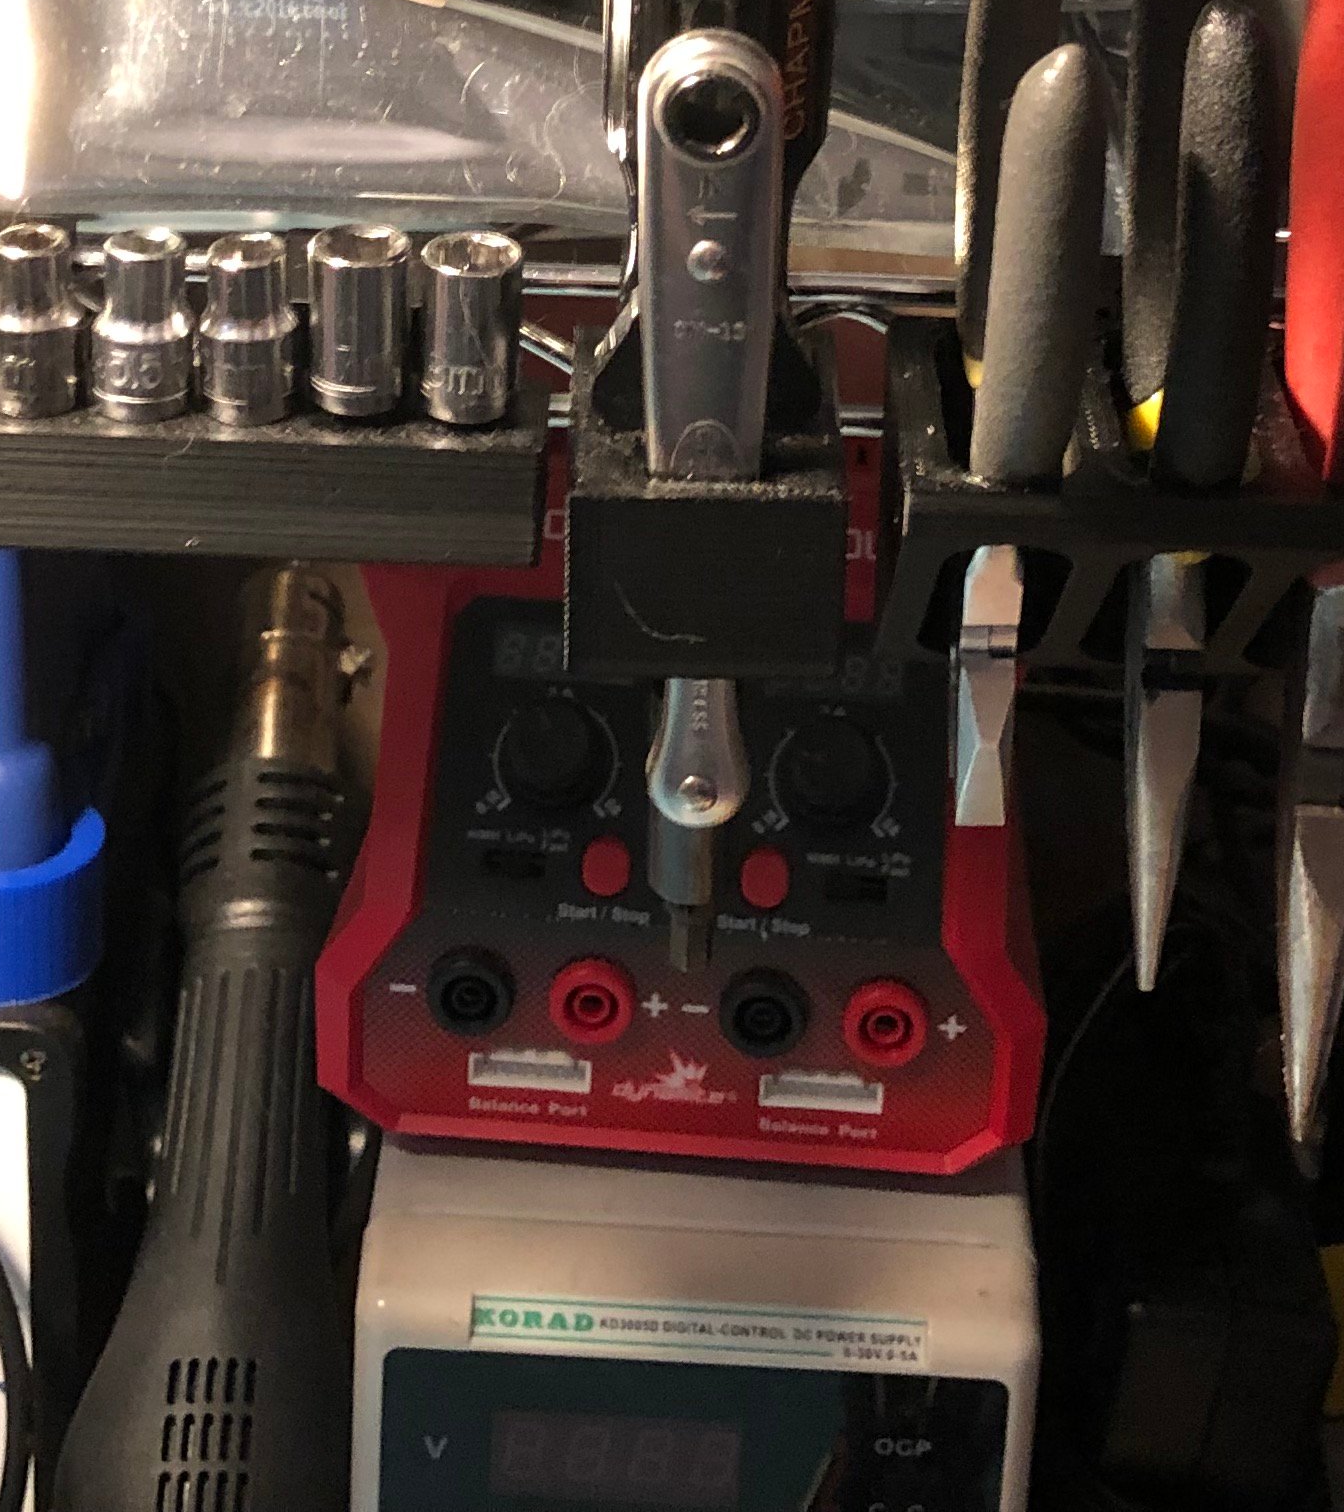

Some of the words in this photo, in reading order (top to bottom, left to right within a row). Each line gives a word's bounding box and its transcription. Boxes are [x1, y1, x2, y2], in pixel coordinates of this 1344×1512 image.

[558, 902, 597, 919] Start
[716, 914, 756, 932] Start
[468, 1095, 540, 1116] Balance
[548, 1102, 588, 1118] Port
[759, 1115, 829, 1137] Balance
[837, 1124, 878, 1141] Port
[474, 1307, 594, 1332] KORAD
[816, 1329, 866, 1344] POWER
[870, 1332, 921, 1347] SUPPLY
[423, 1434, 448, 1460] V
[874, 1435, 932, 1457] OCP
